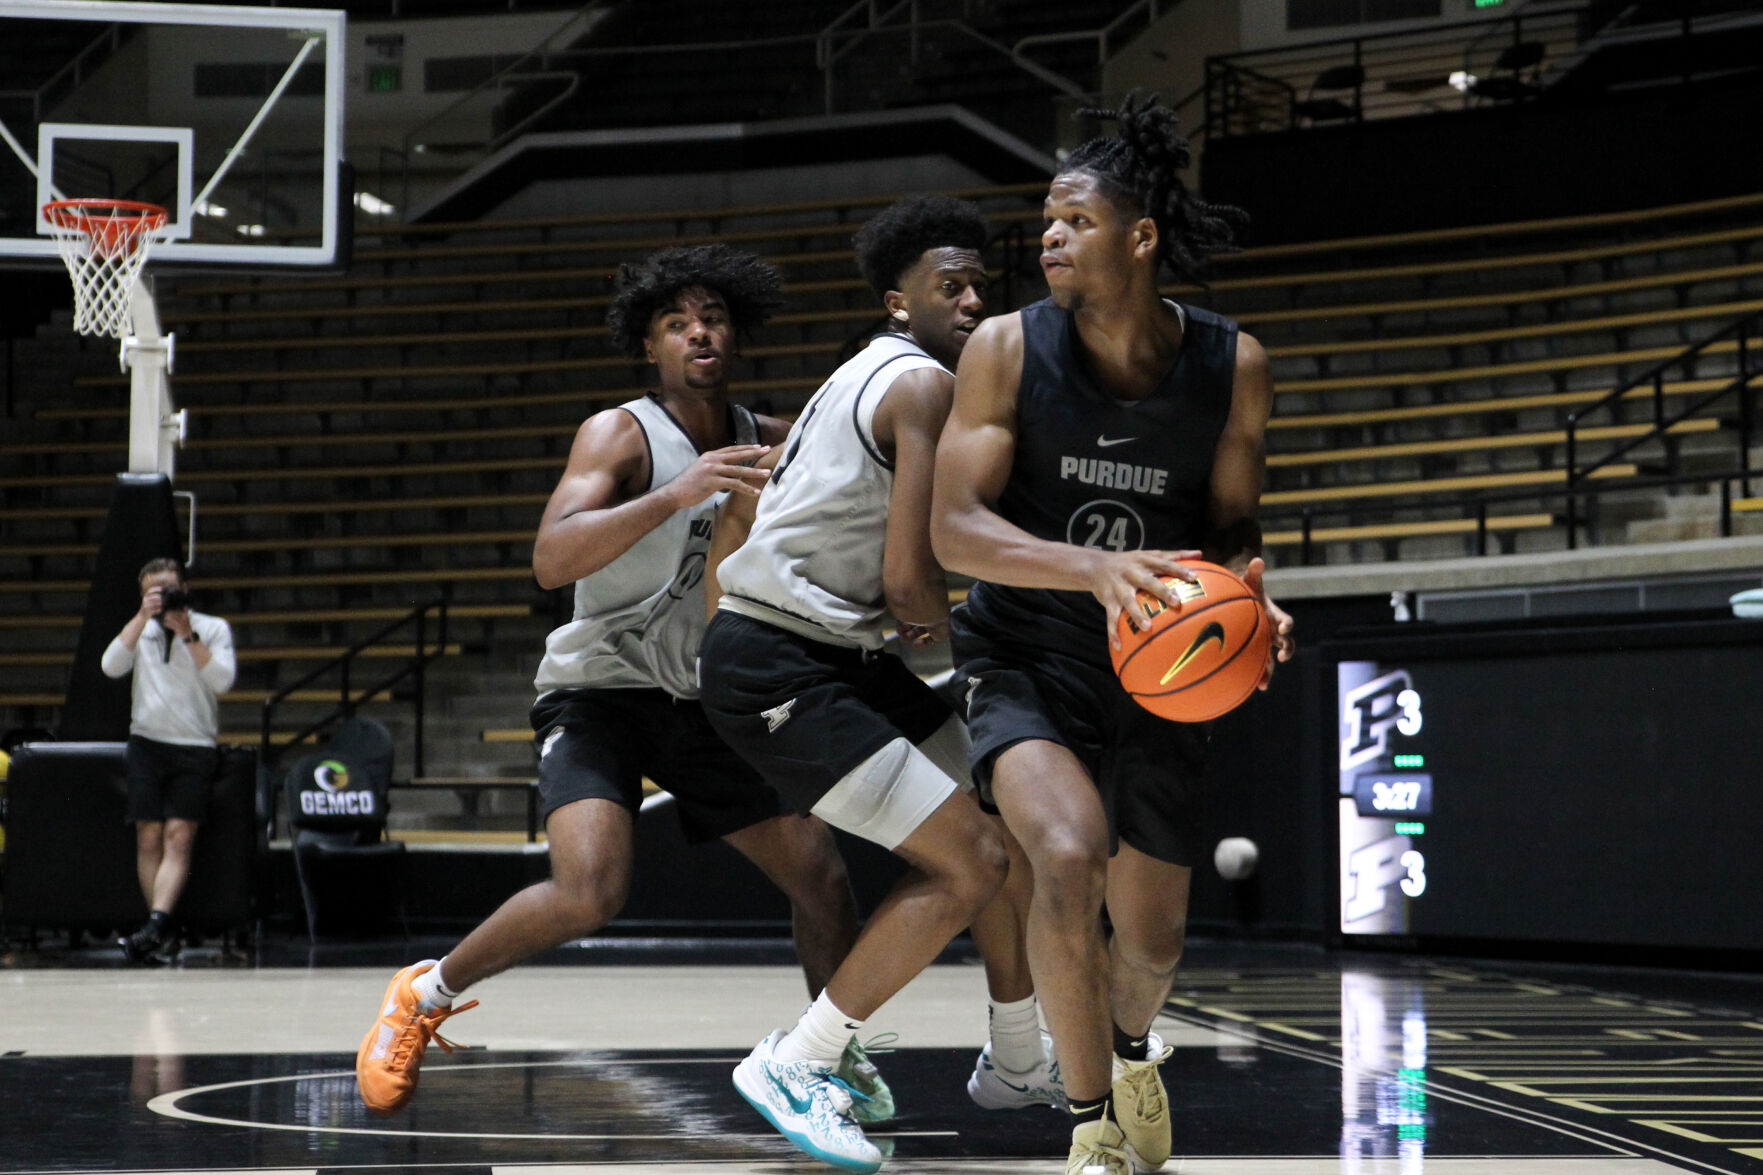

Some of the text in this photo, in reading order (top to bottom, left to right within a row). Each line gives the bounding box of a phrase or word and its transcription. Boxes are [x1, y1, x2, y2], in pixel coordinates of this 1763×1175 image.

[1060, 455, 1168, 495] PURDUE
[1084, 513, 1128, 552] 24
[1396, 689, 1424, 736] 3
[300, 790, 375, 815] GEMCO
[1400, 850, 1427, 897] 3
